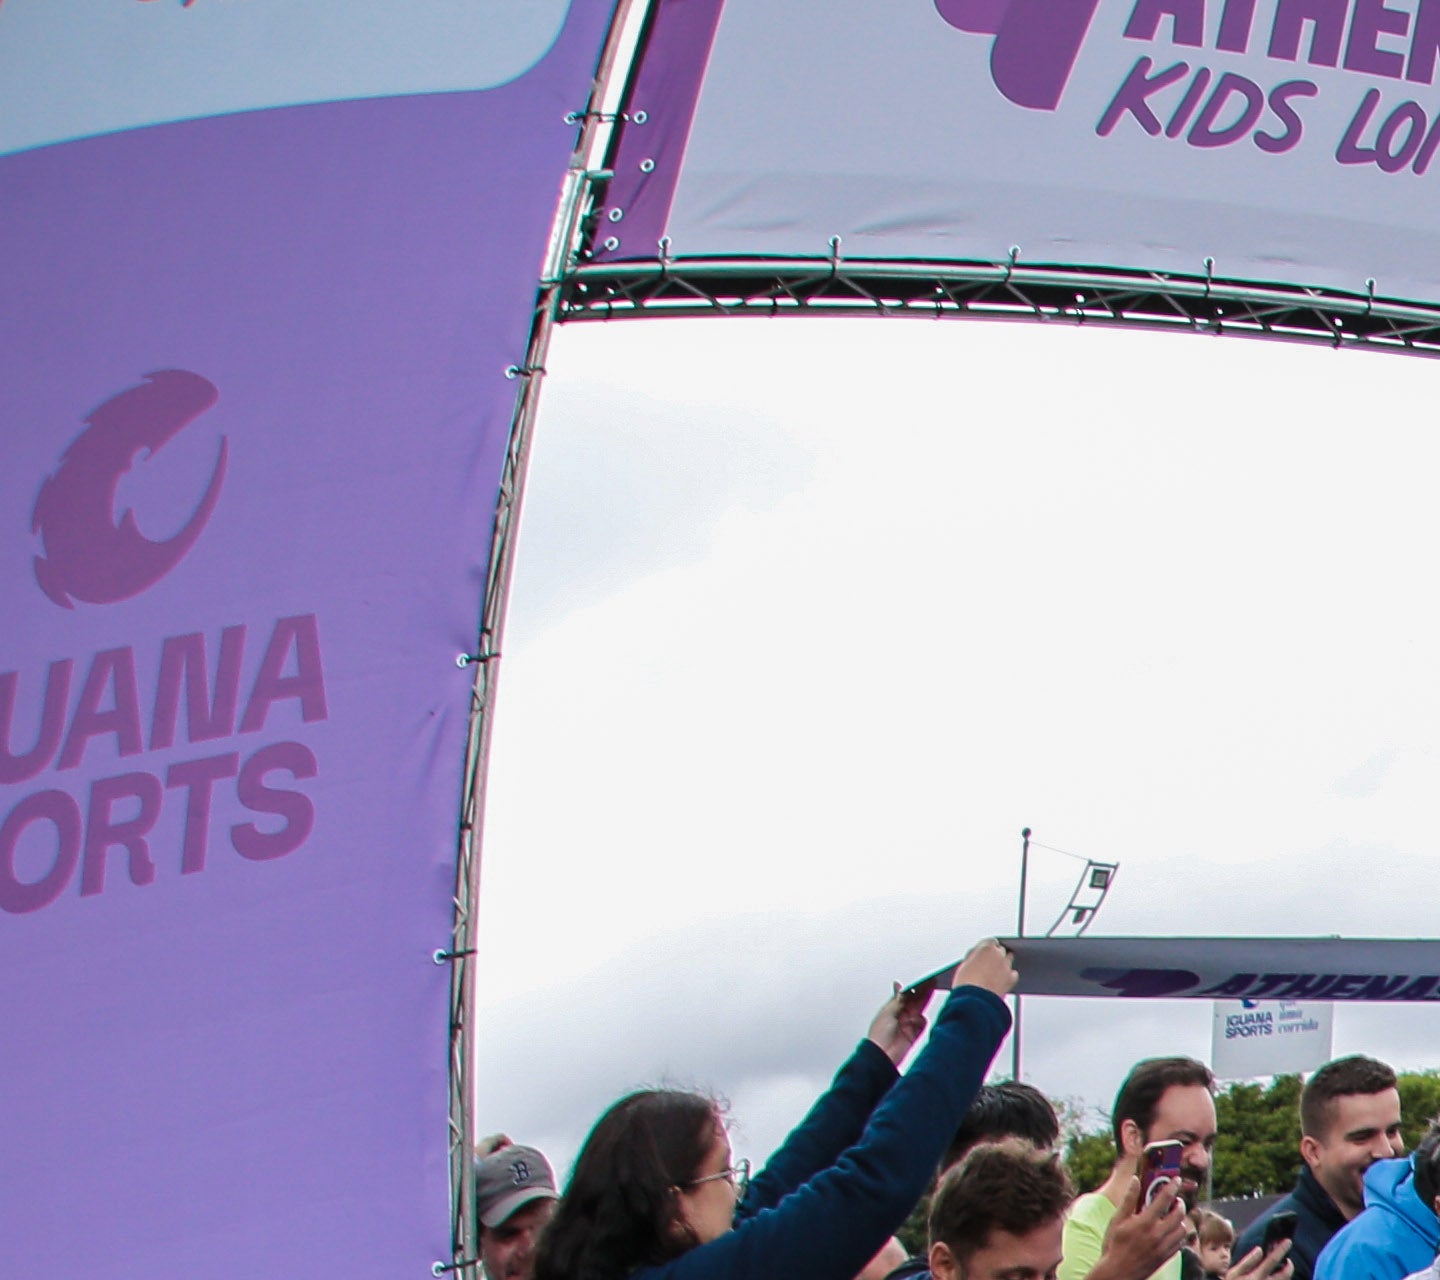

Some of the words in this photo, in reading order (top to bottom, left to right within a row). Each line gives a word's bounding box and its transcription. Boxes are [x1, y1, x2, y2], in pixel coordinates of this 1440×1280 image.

[1095, 55, 1319, 154] KIDS
[0, 613, 328, 785] UANA
[0, 741, 318, 914] ORTS
[1226, 1011, 1273, 1027] IGUANA
[1226, 1023, 1273, 1039] SPORTS
